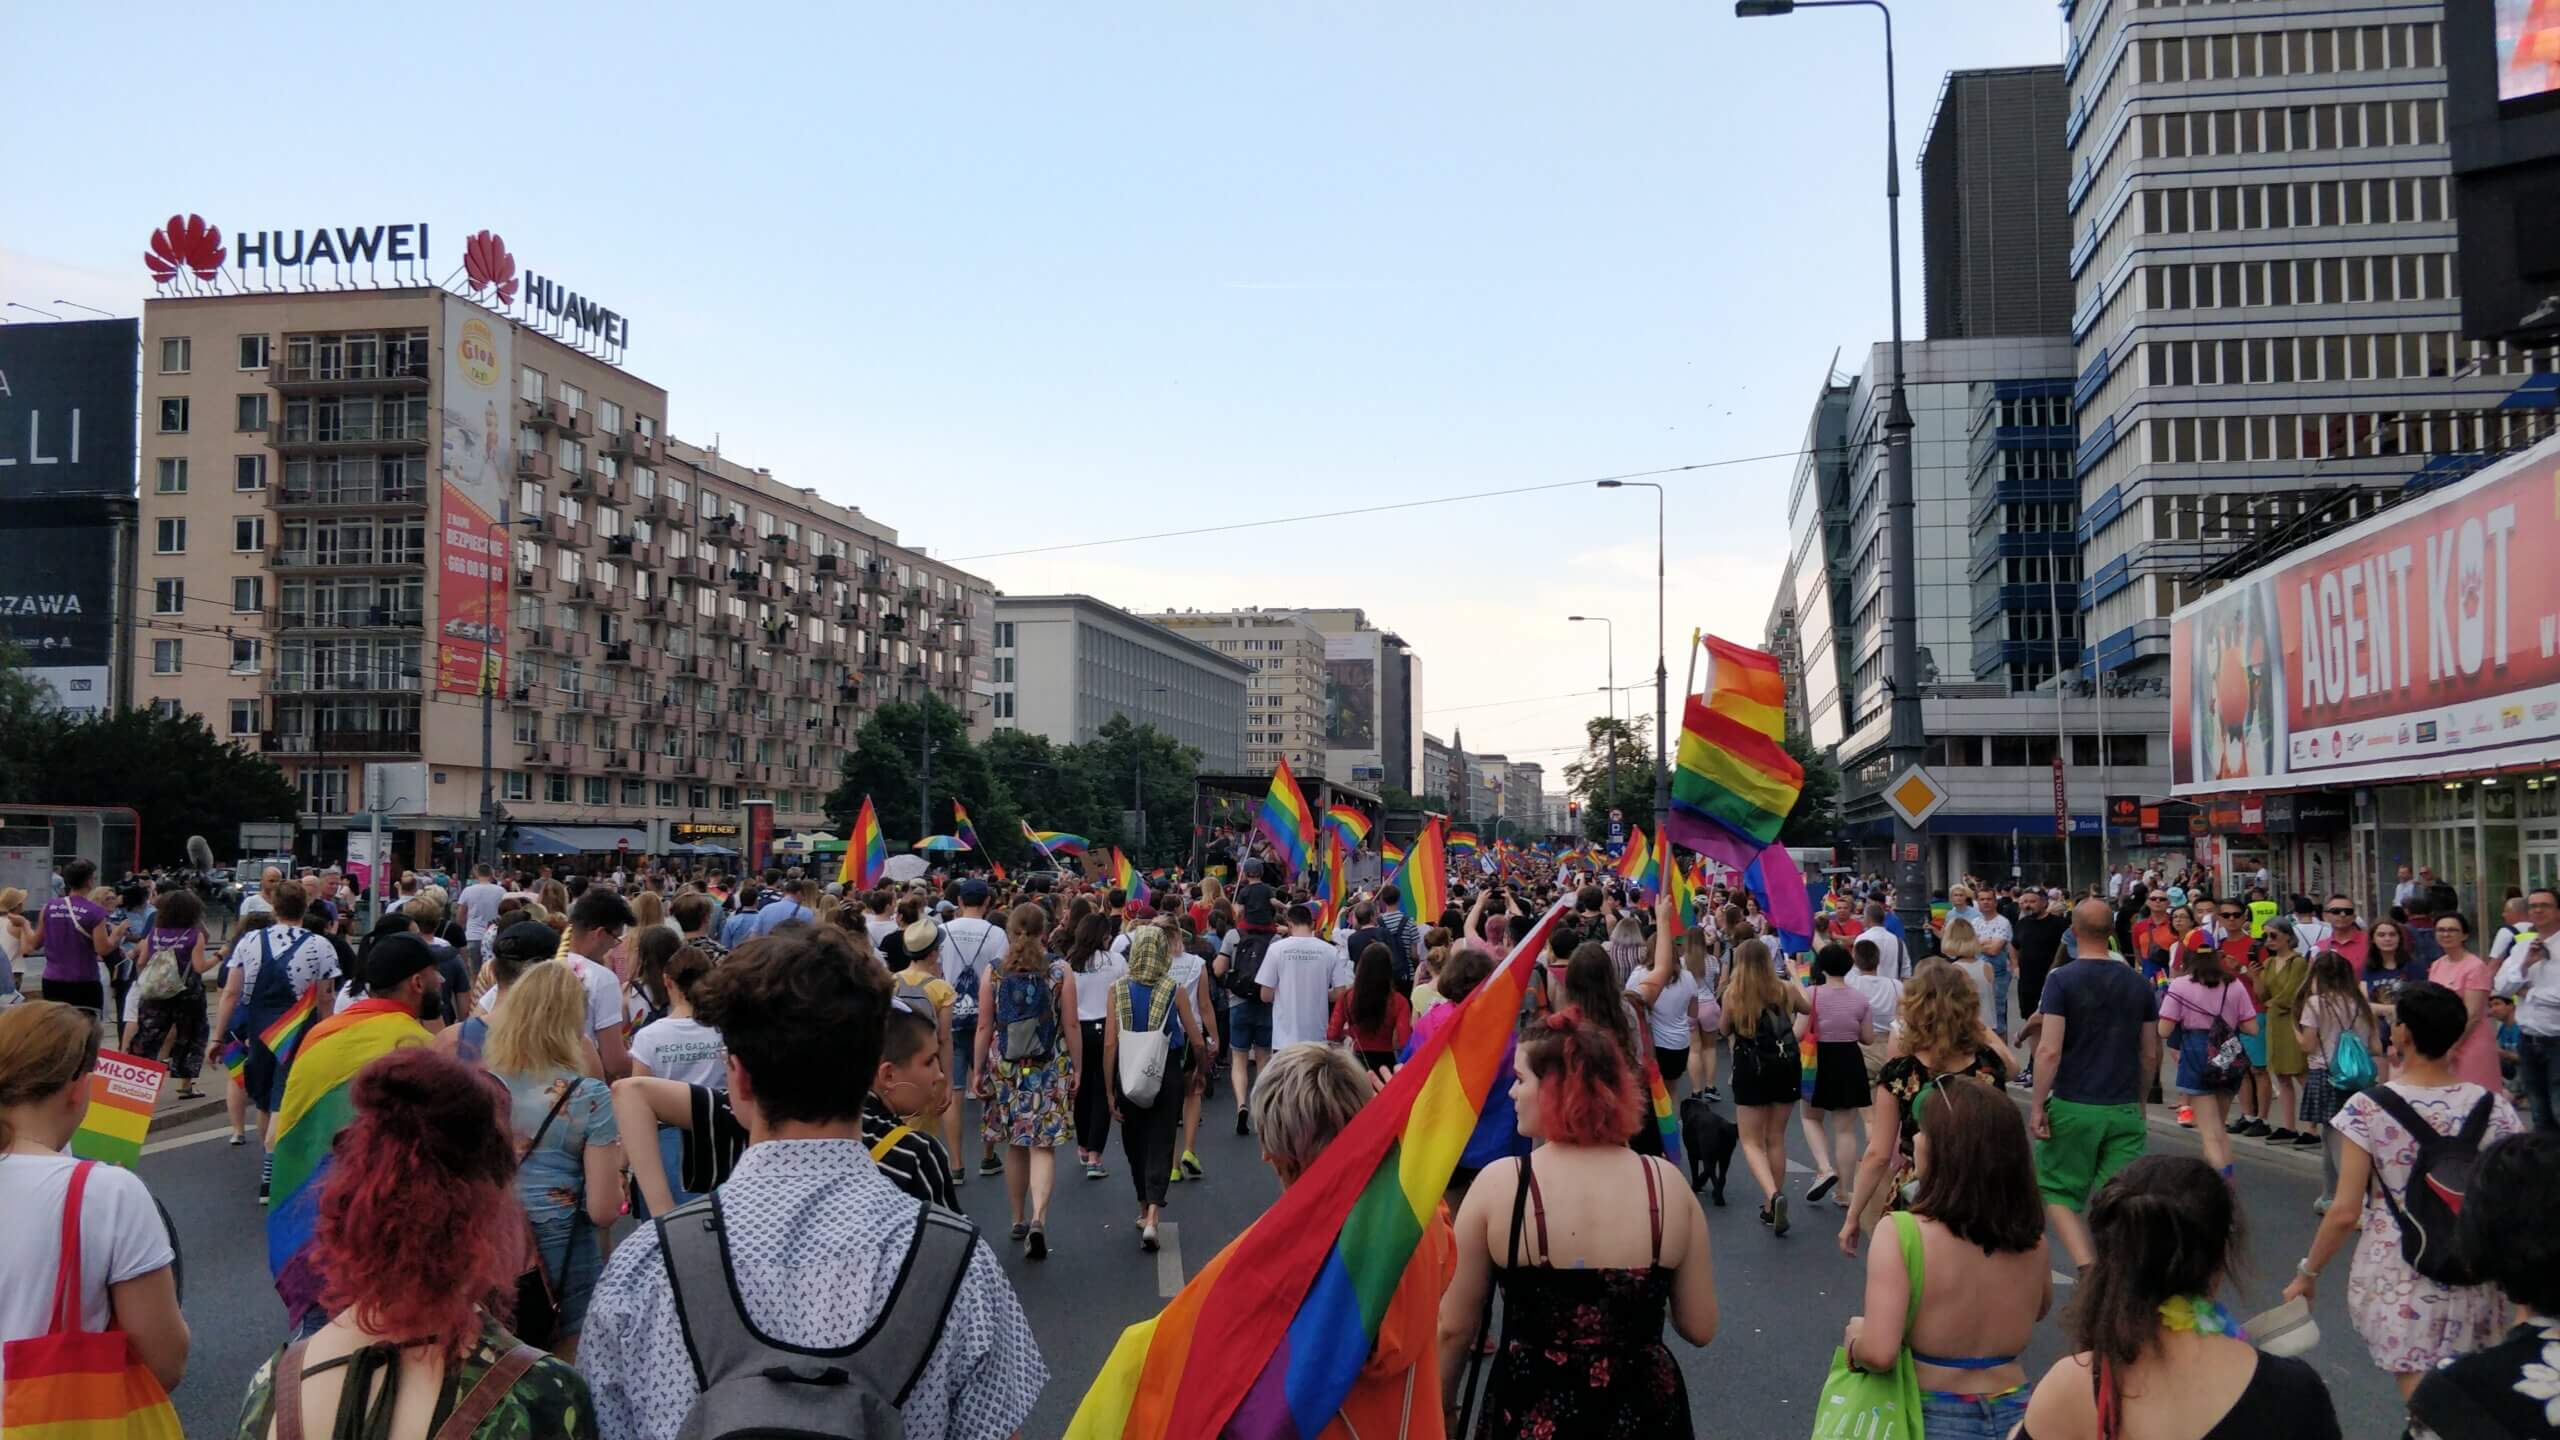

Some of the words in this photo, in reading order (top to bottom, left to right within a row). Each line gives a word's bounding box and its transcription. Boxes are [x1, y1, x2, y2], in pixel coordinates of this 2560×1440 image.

[237, 222, 429, 269] HUAWEI
[525, 269, 628, 350] HUAWEI
[0, 594, 82, 615] ZAWA
[2301, 544, 2411, 708] AGENT
[2426, 504, 2515, 681] KOT
[1612, 823, 1621, 834] P
[95, 1061, 158, 1086] MIŁOŚĆ
